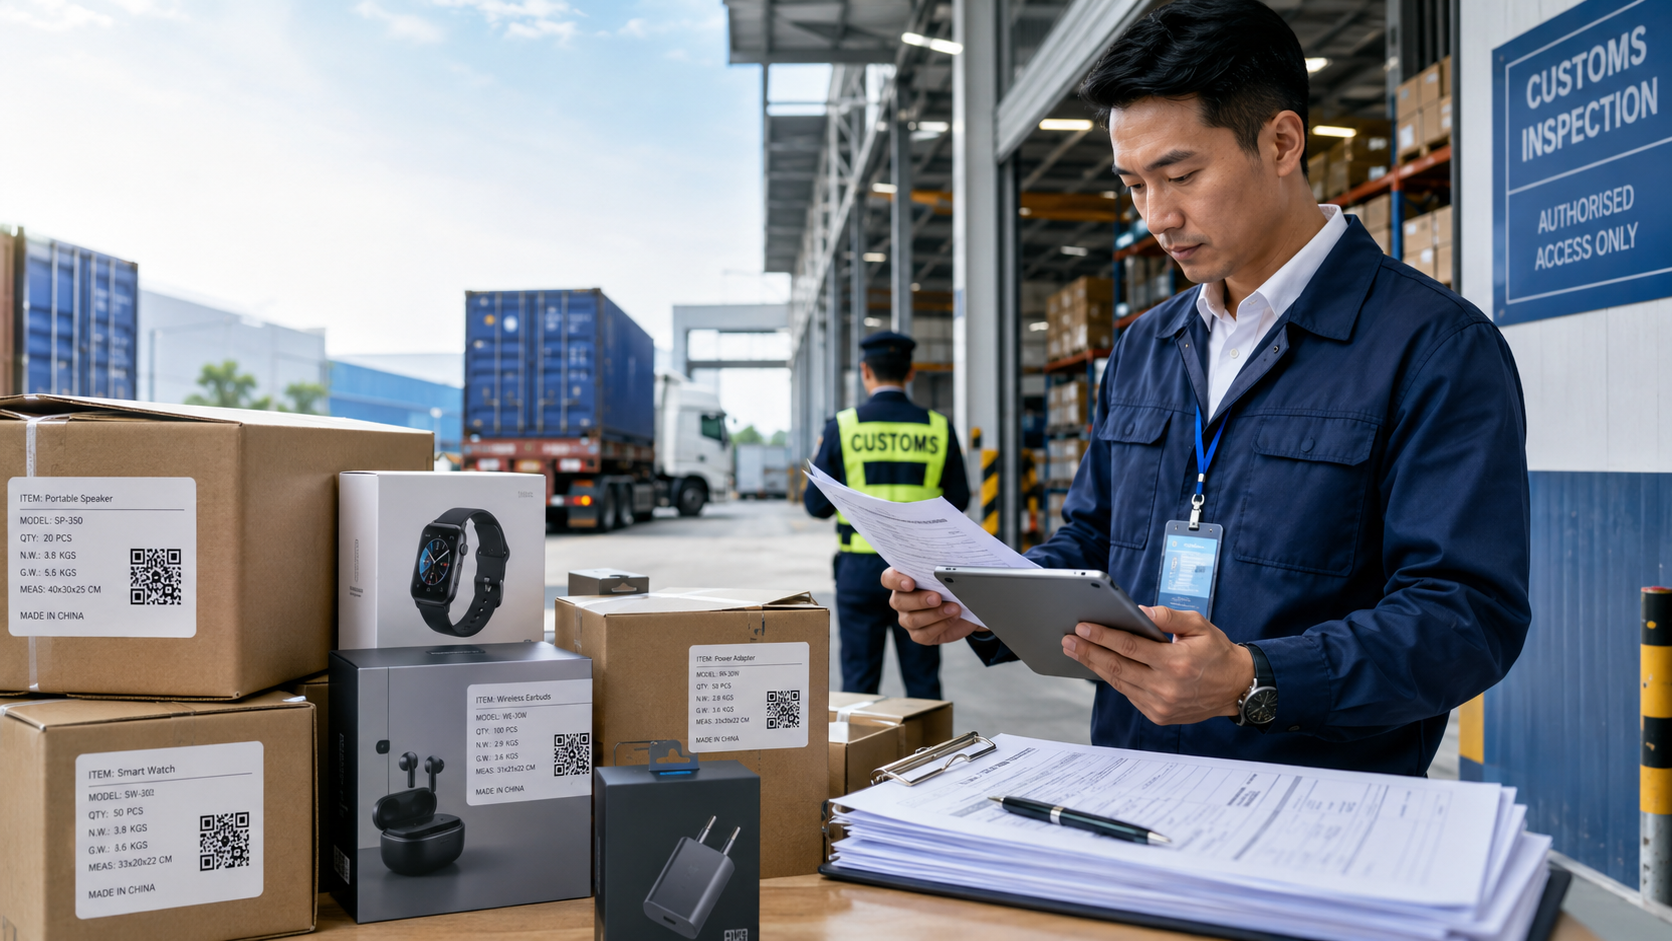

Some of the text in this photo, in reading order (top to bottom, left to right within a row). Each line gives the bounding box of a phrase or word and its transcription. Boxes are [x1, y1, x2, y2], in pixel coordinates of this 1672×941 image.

[1526, 25, 1647, 110] CUSTOMS
[1522, 76, 1658, 163] INSPECTION
[1537, 184, 1634, 235] AUTHORISED
[1534, 221, 1639, 271] ACCESS ONLY
[851, 432, 939, 455] CUSTOMS
[19, 494, 113, 505] ITEM: Portable Speaker
[19, 516, 84, 525] MODEL: SP-350
[19, 533, 73, 543] QTY: 20 PCS
[19, 551, 41, 560] N.W.:
[59, 551, 77, 560] KGS
[19, 568, 42, 577] G.W.:
[59, 568, 77, 577] KGS
[19, 585, 102, 594] MEAS: 40x30x25 CM
[19, 611, 85, 620] MADE IN CHINA
[733, 654, 756, 663] Adapter
[476, 696, 495, 704] ITEM:
[496, 694, 525, 703] Wireless
[505, 725, 518, 733] PCS
[505, 739, 519, 747] KGS
[505, 752, 519, 760] KGS
[88, 764, 176, 780] ITEM: Smart Watch
[475, 787, 494, 796] MADE
[504, 785, 525, 794] CHINA
[88, 791, 122, 802] MODEL:
[88, 806, 144, 820] QTY: 50 PCS
[88, 823, 148, 837] N.W.: 3.8 KGS
[88, 845, 110, 855] G.W.:
[130, 840, 148, 850] KGS
[88, 855, 173, 872] MEAS: 33x20x22 CM
[88, 883, 156, 899] MADE IN CHINA
